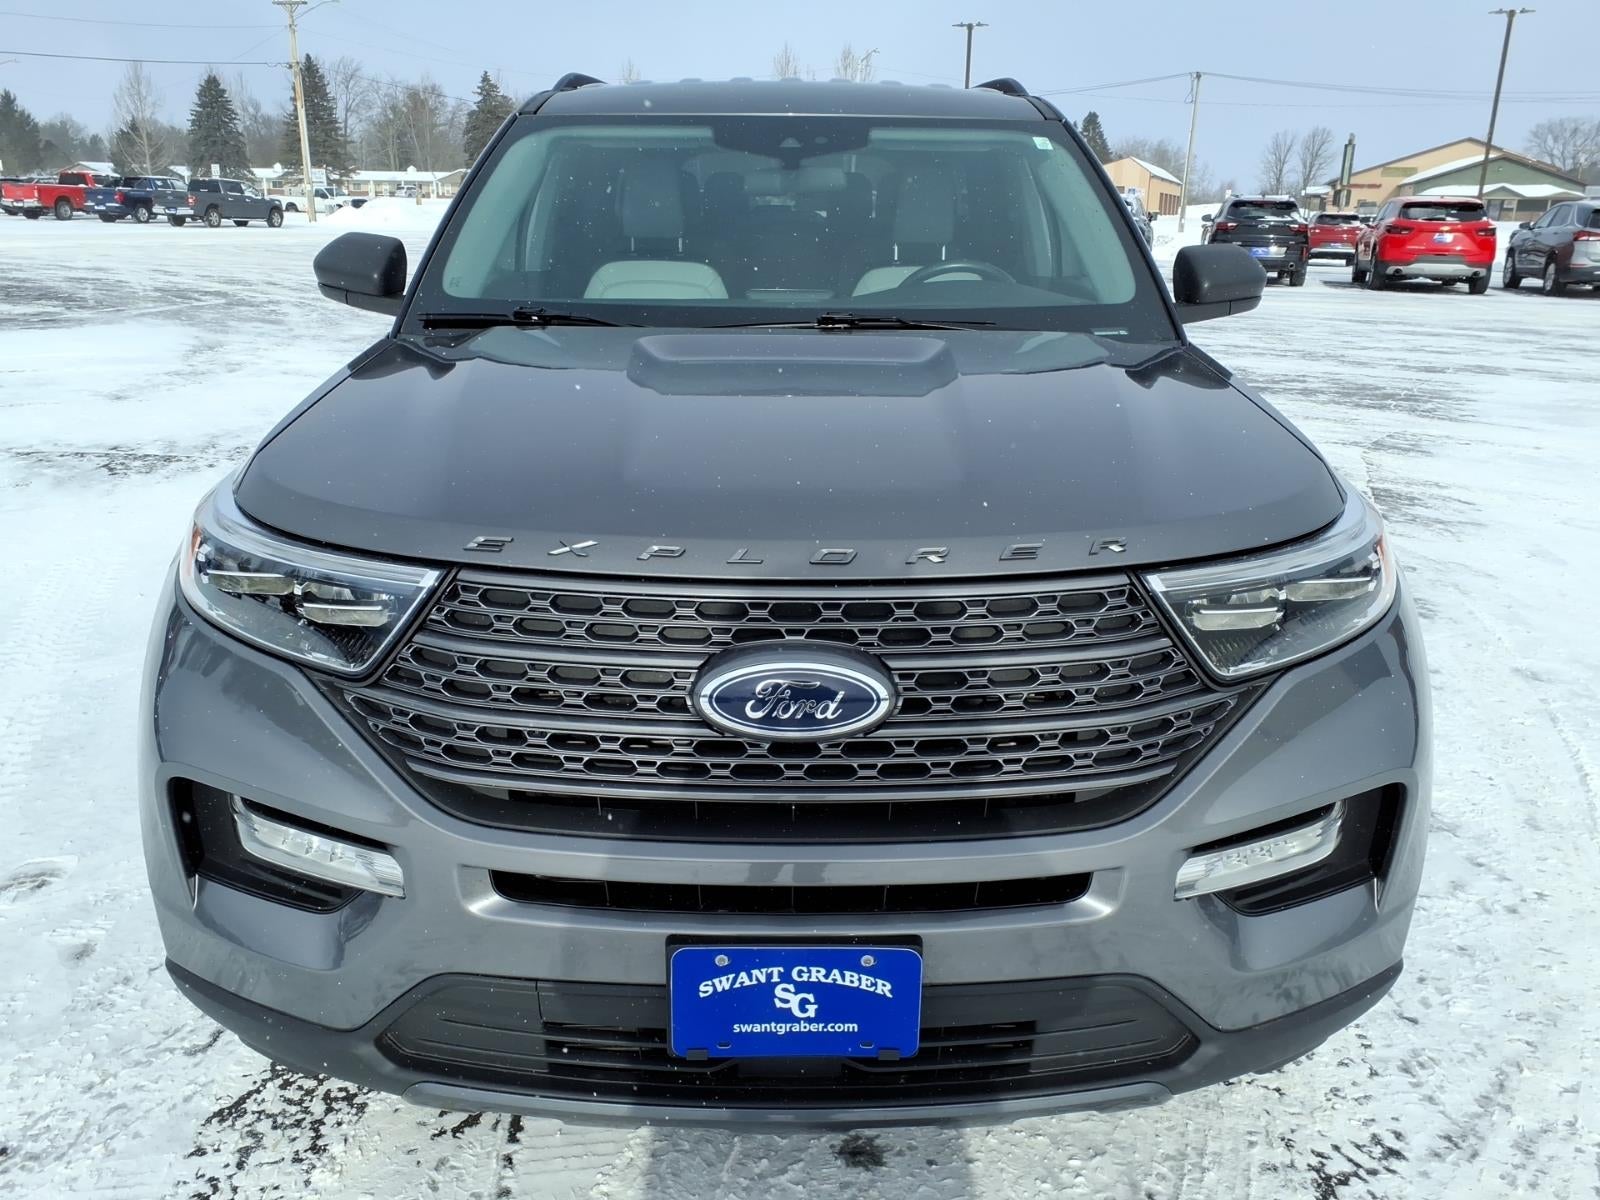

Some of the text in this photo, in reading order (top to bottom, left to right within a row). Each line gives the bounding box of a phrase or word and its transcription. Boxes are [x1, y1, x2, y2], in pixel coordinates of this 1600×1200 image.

[461, 534, 1128, 566] EXPLORER
[744, 678, 846, 720] Ford
[698, 965, 893, 998] SWANT GRABER
[773, 982, 818, 1019] SG
[732, 1020, 858, 1035] swantgraber.com
